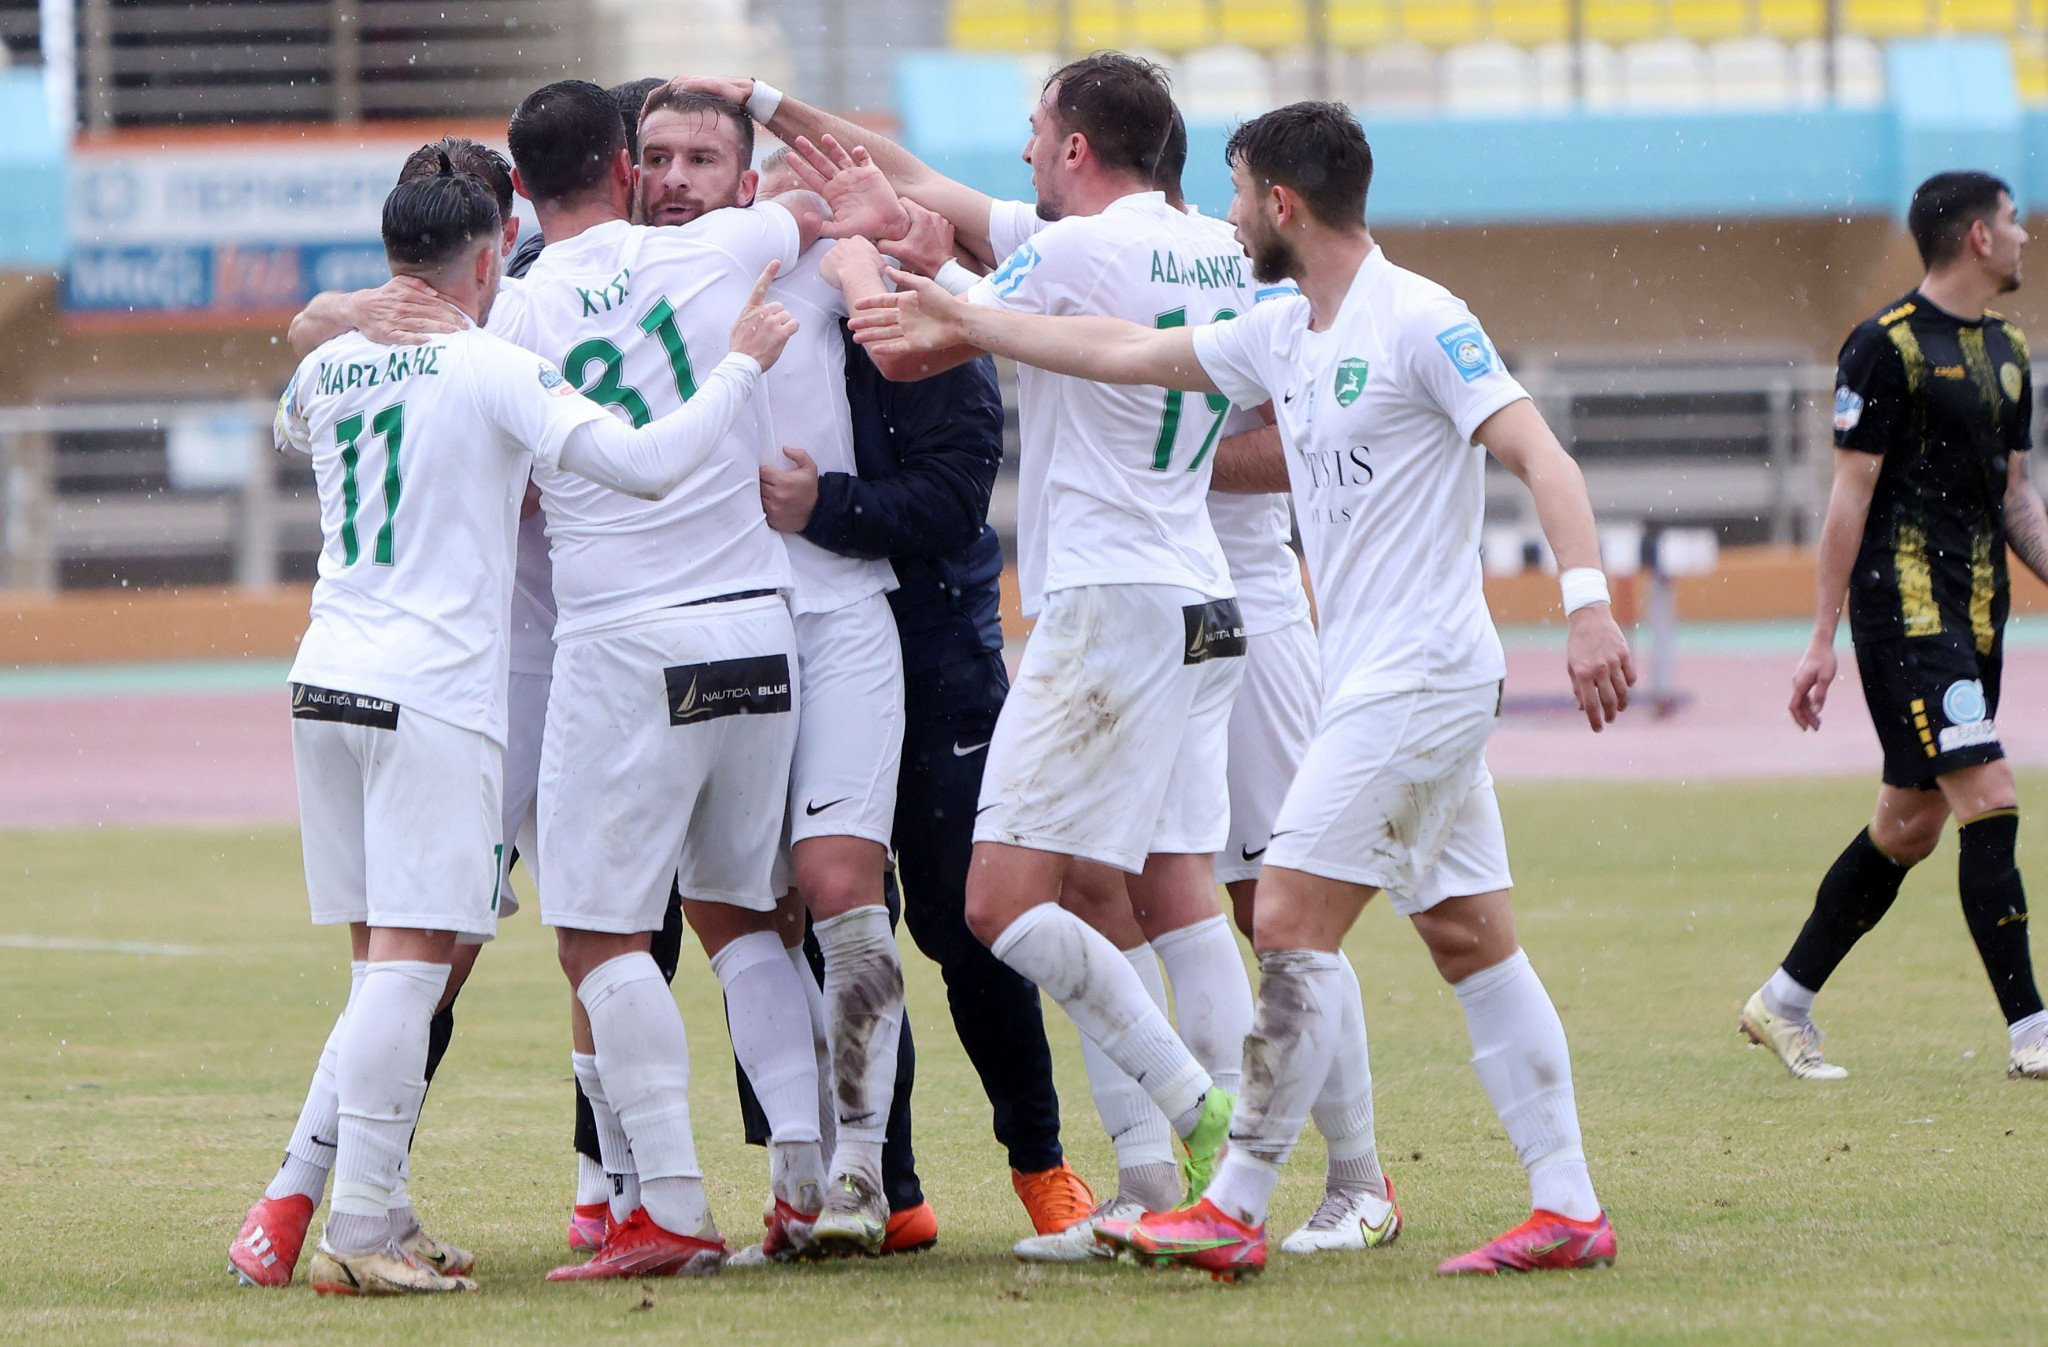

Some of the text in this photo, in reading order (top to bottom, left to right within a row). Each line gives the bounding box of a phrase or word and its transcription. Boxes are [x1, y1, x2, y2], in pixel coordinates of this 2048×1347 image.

[333, 400, 406, 568] 11
[307, 692, 394, 713] NAUTICA BLUE
[702, 684, 788, 703] NAUTICA BLUE
